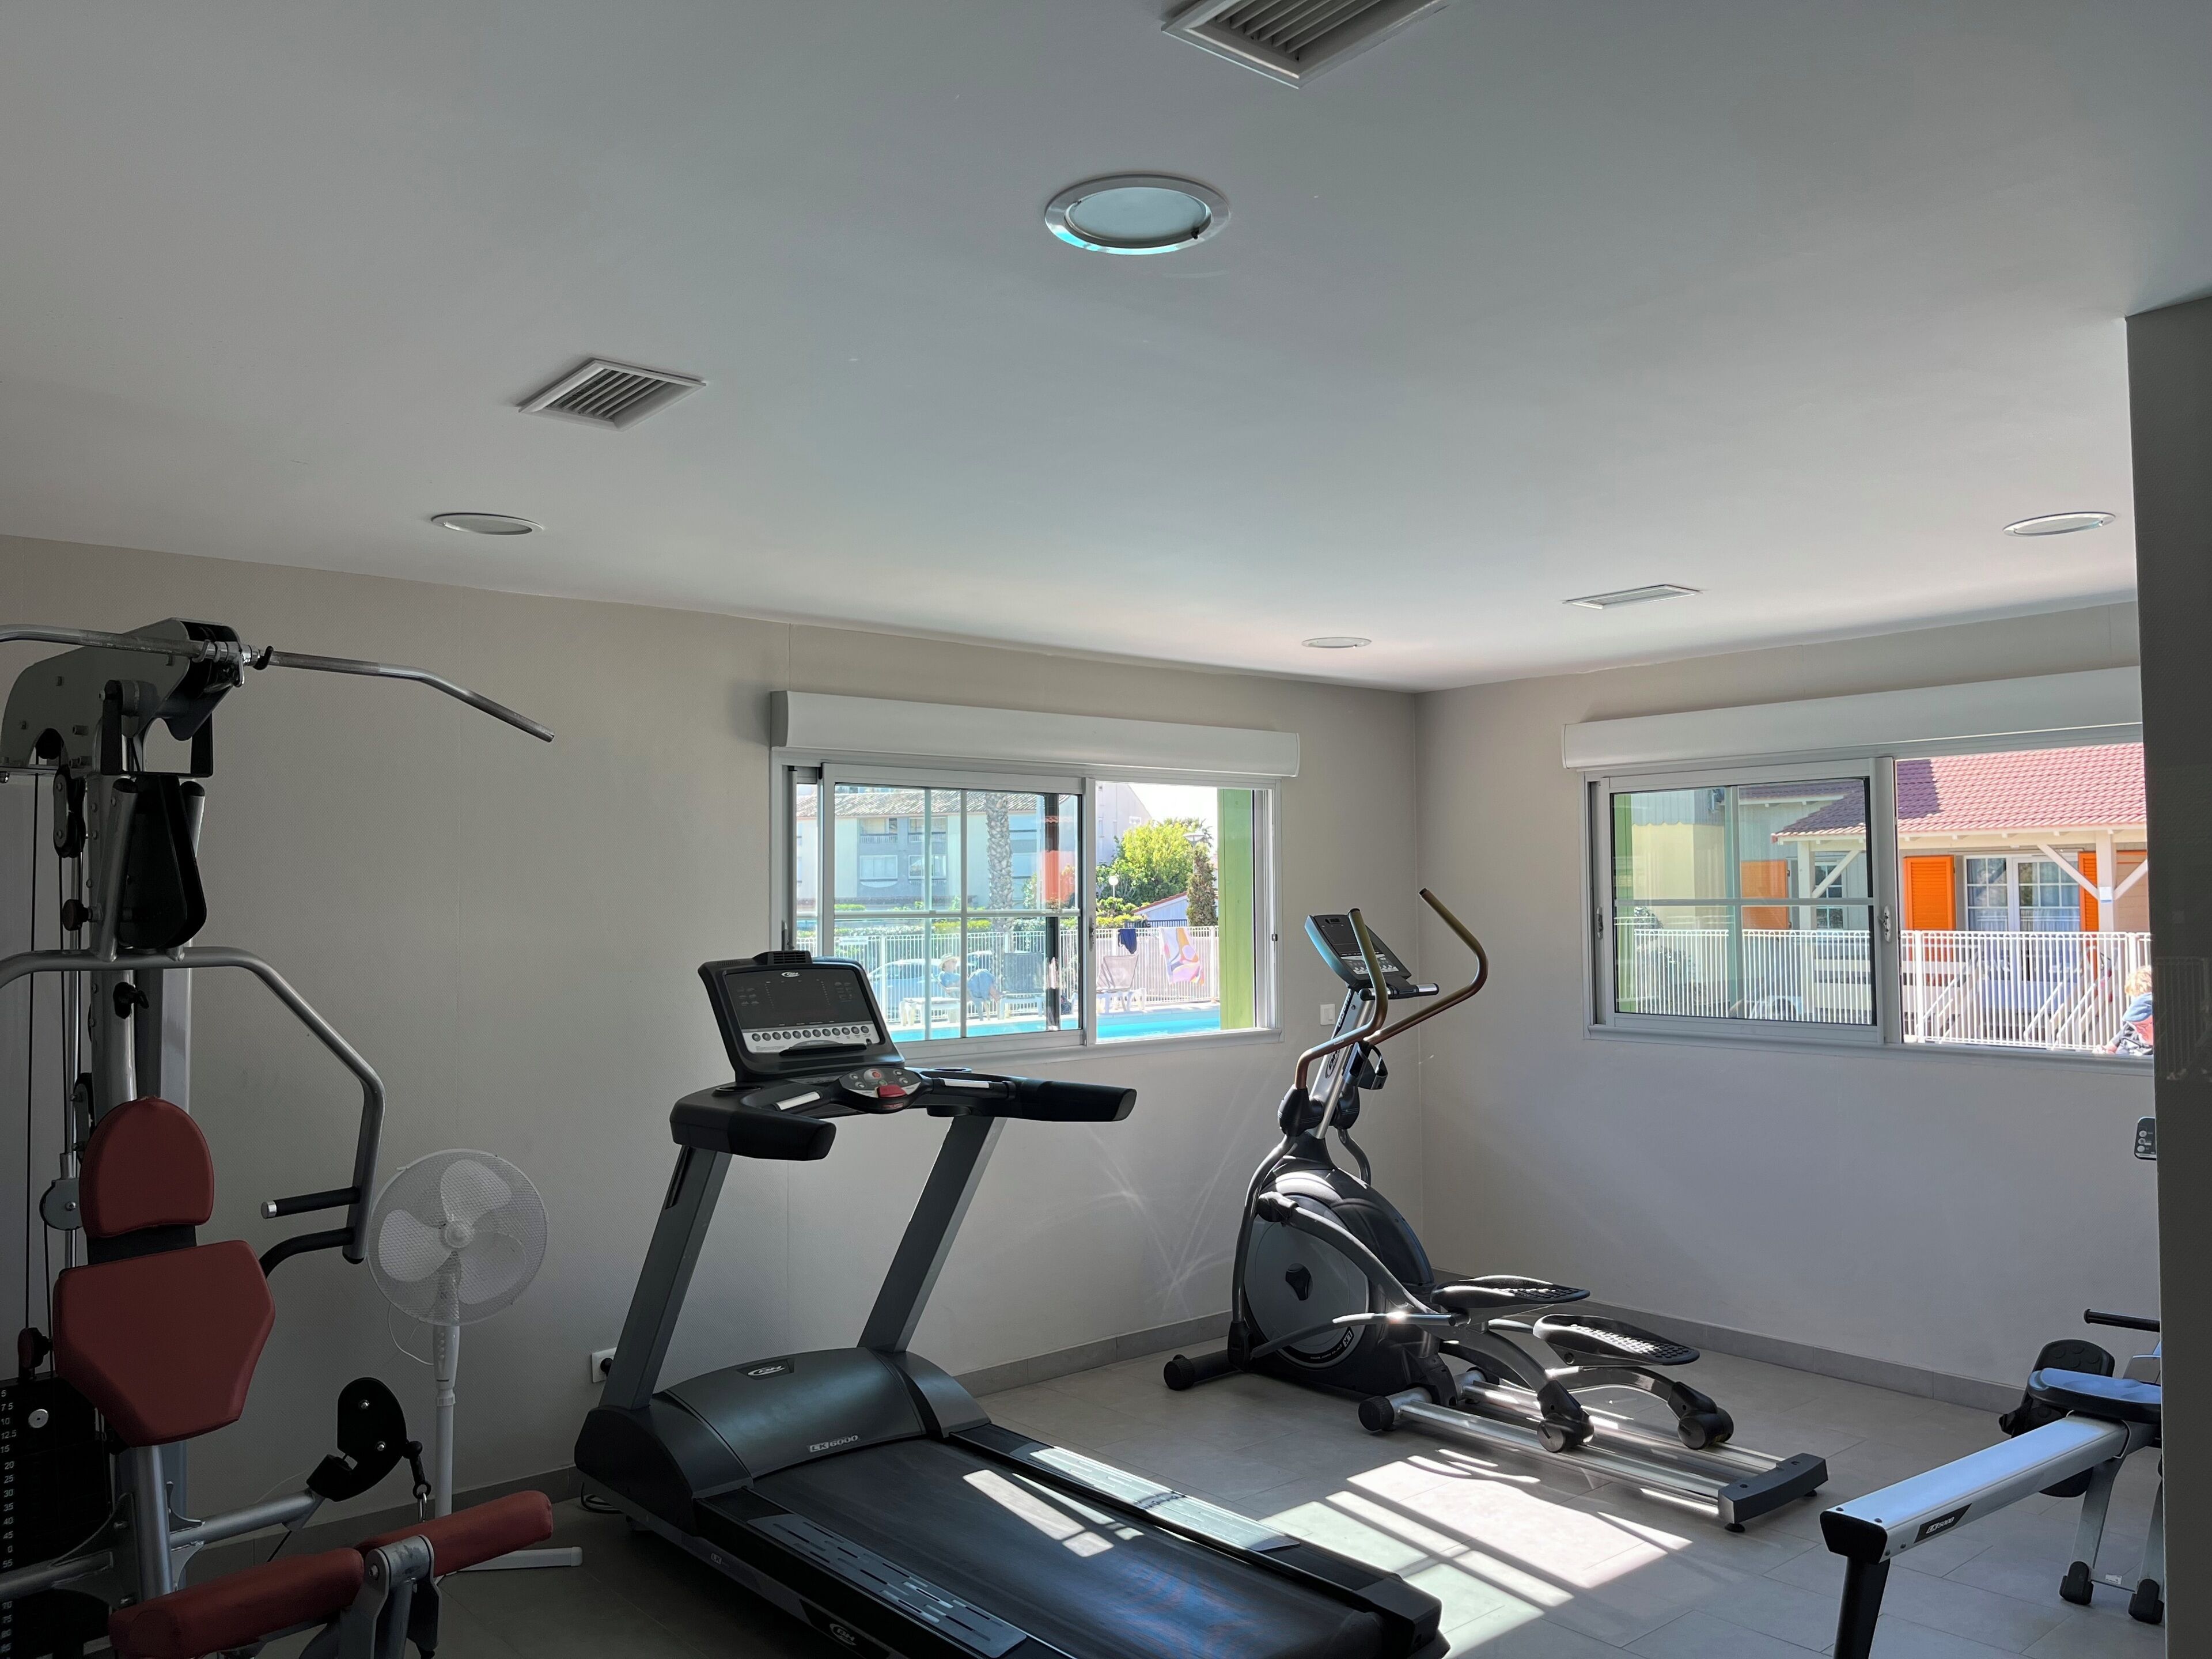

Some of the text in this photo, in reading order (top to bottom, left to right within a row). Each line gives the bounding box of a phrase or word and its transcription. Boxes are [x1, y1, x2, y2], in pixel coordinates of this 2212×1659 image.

[1343, 1332, 1352, 1346] LK
[1, 1417, 10, 1426] 10
[1, 1444, 11, 1453] 15
[5, 1461, 14, 1470] 20
[4, 1474, 14, 1484] 25
[4, 1488, 14, 1498] 30
[3, 1502, 14, 1512] 35
[3, 1516, 14, 1525] 40
[3, 1531, 14, 1539] 45
